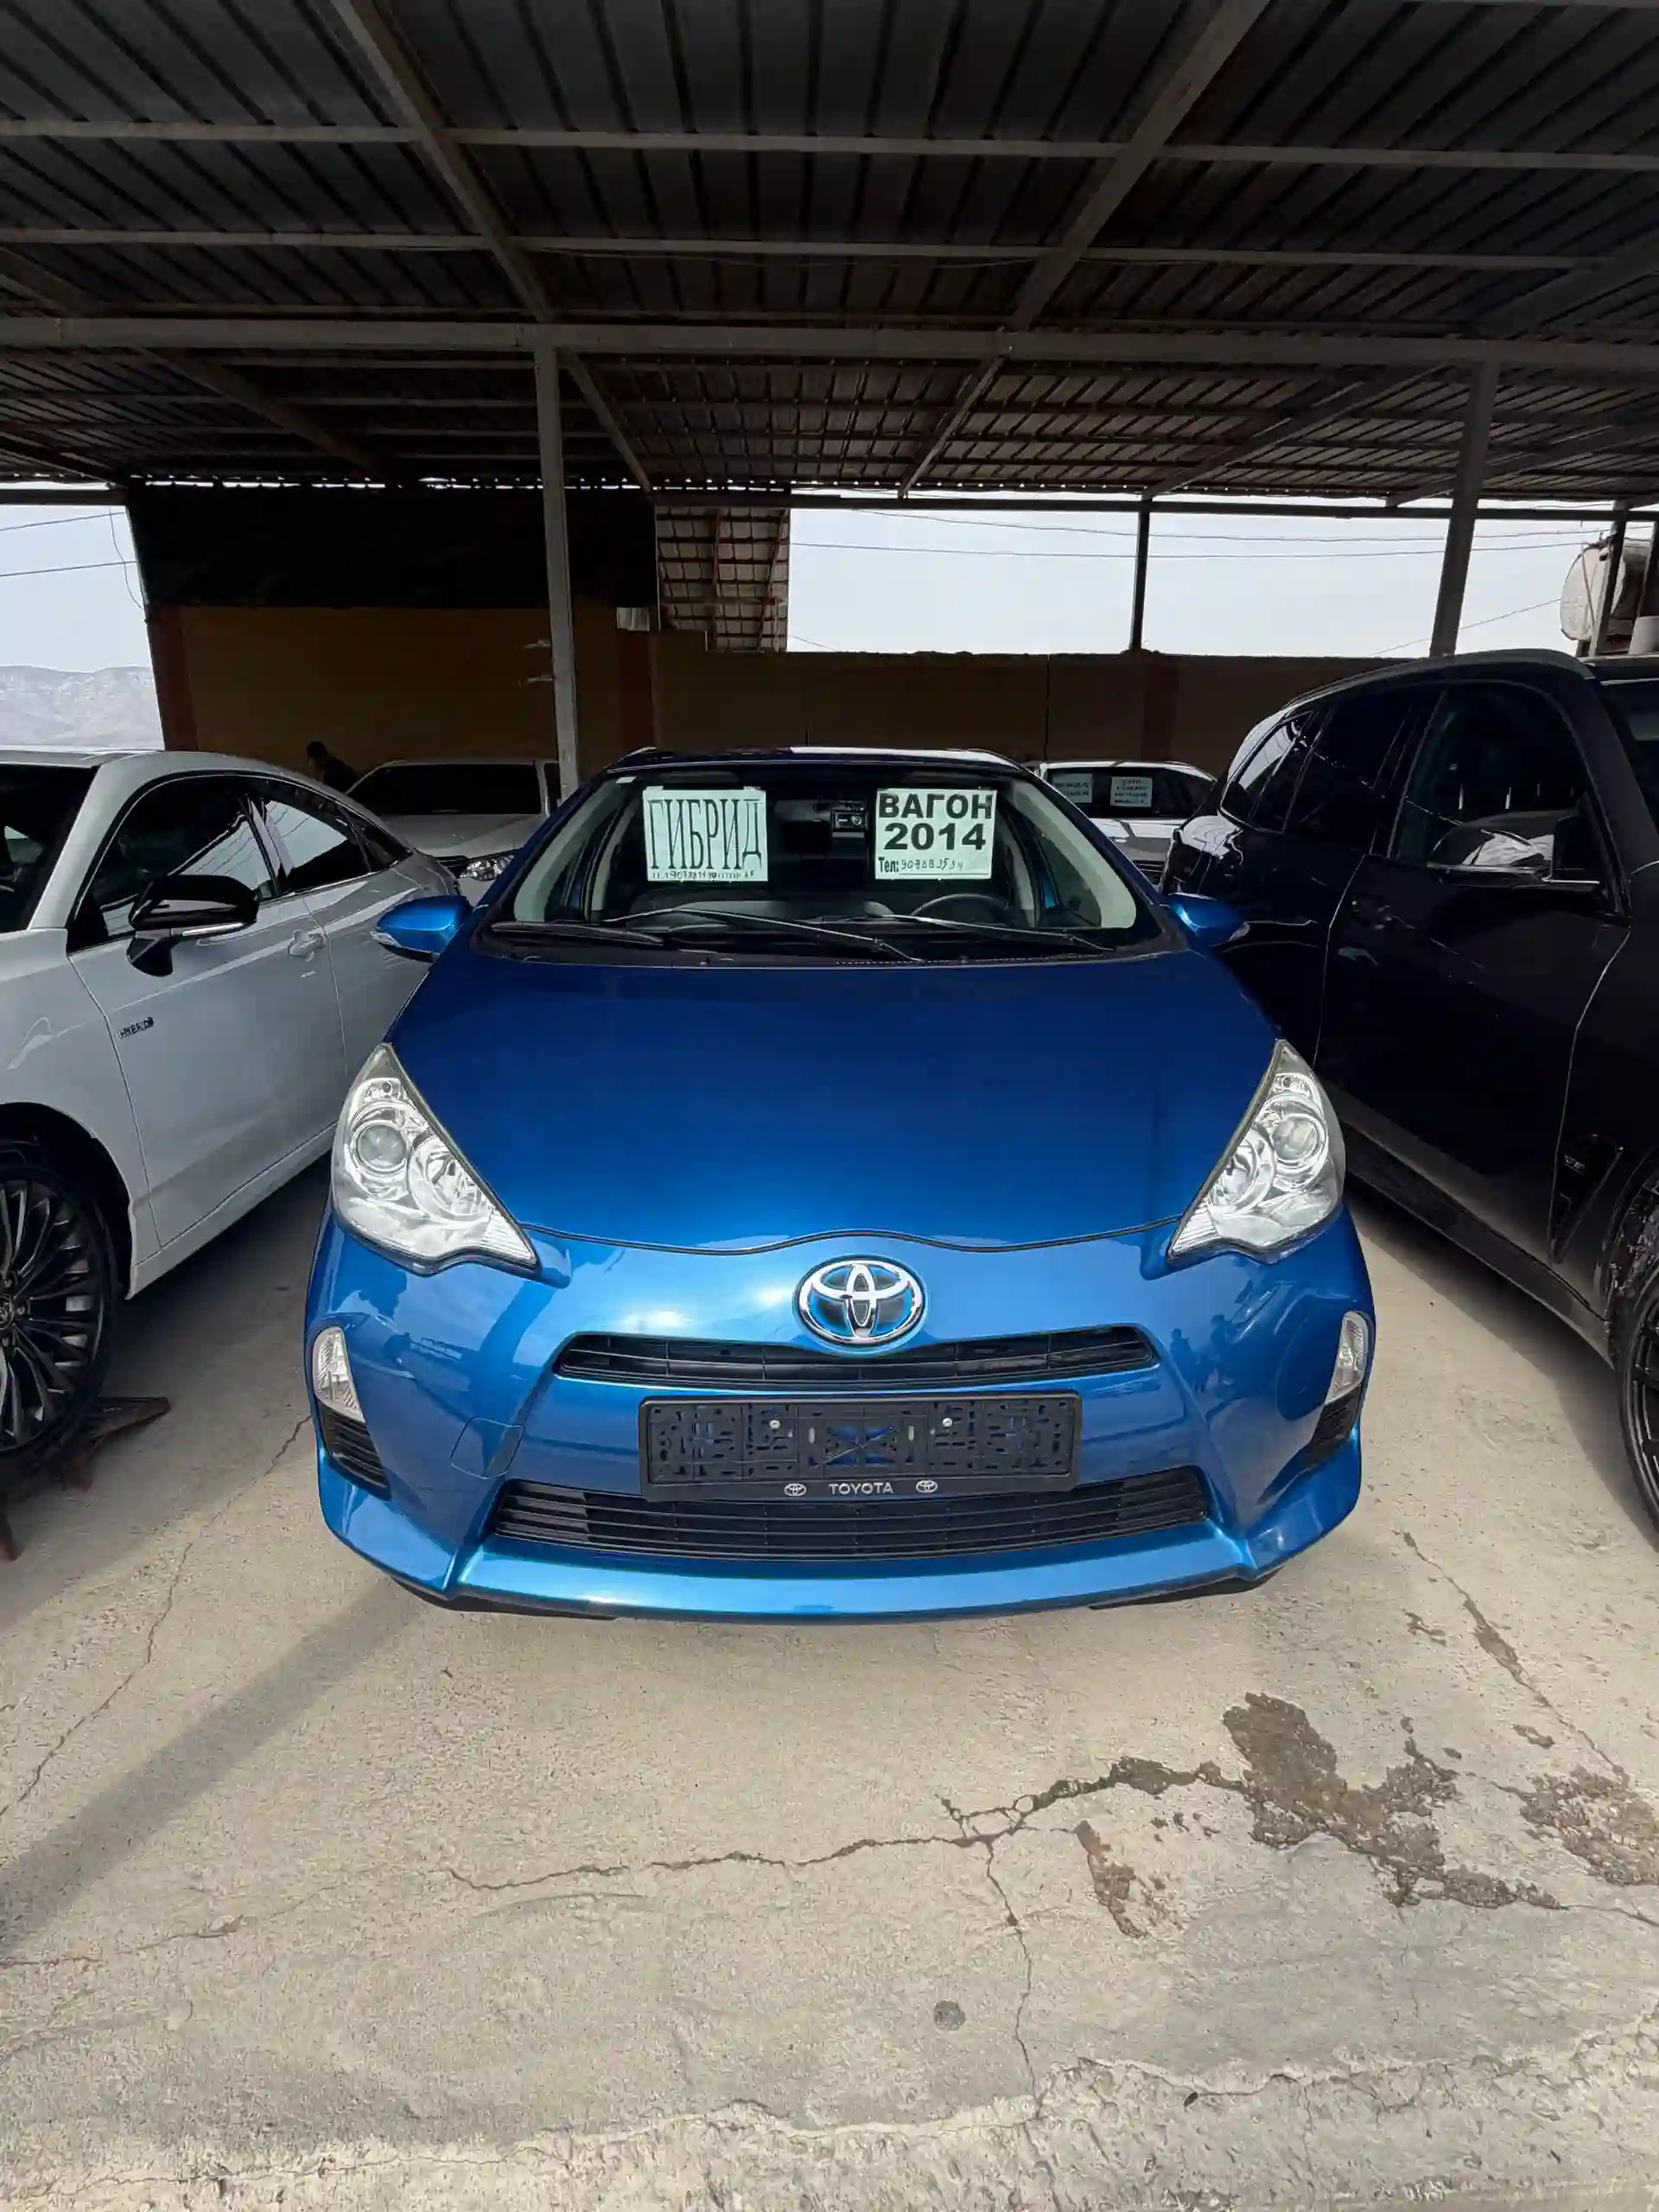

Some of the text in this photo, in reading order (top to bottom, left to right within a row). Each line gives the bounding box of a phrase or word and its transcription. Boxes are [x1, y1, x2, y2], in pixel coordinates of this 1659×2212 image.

[878, 792, 993, 819] ВАГОН
[647, 798, 762, 869] ГИБРИД
[884, 823, 986, 850] 2014
[829, 1482, 893, 1494] TOYOTA
